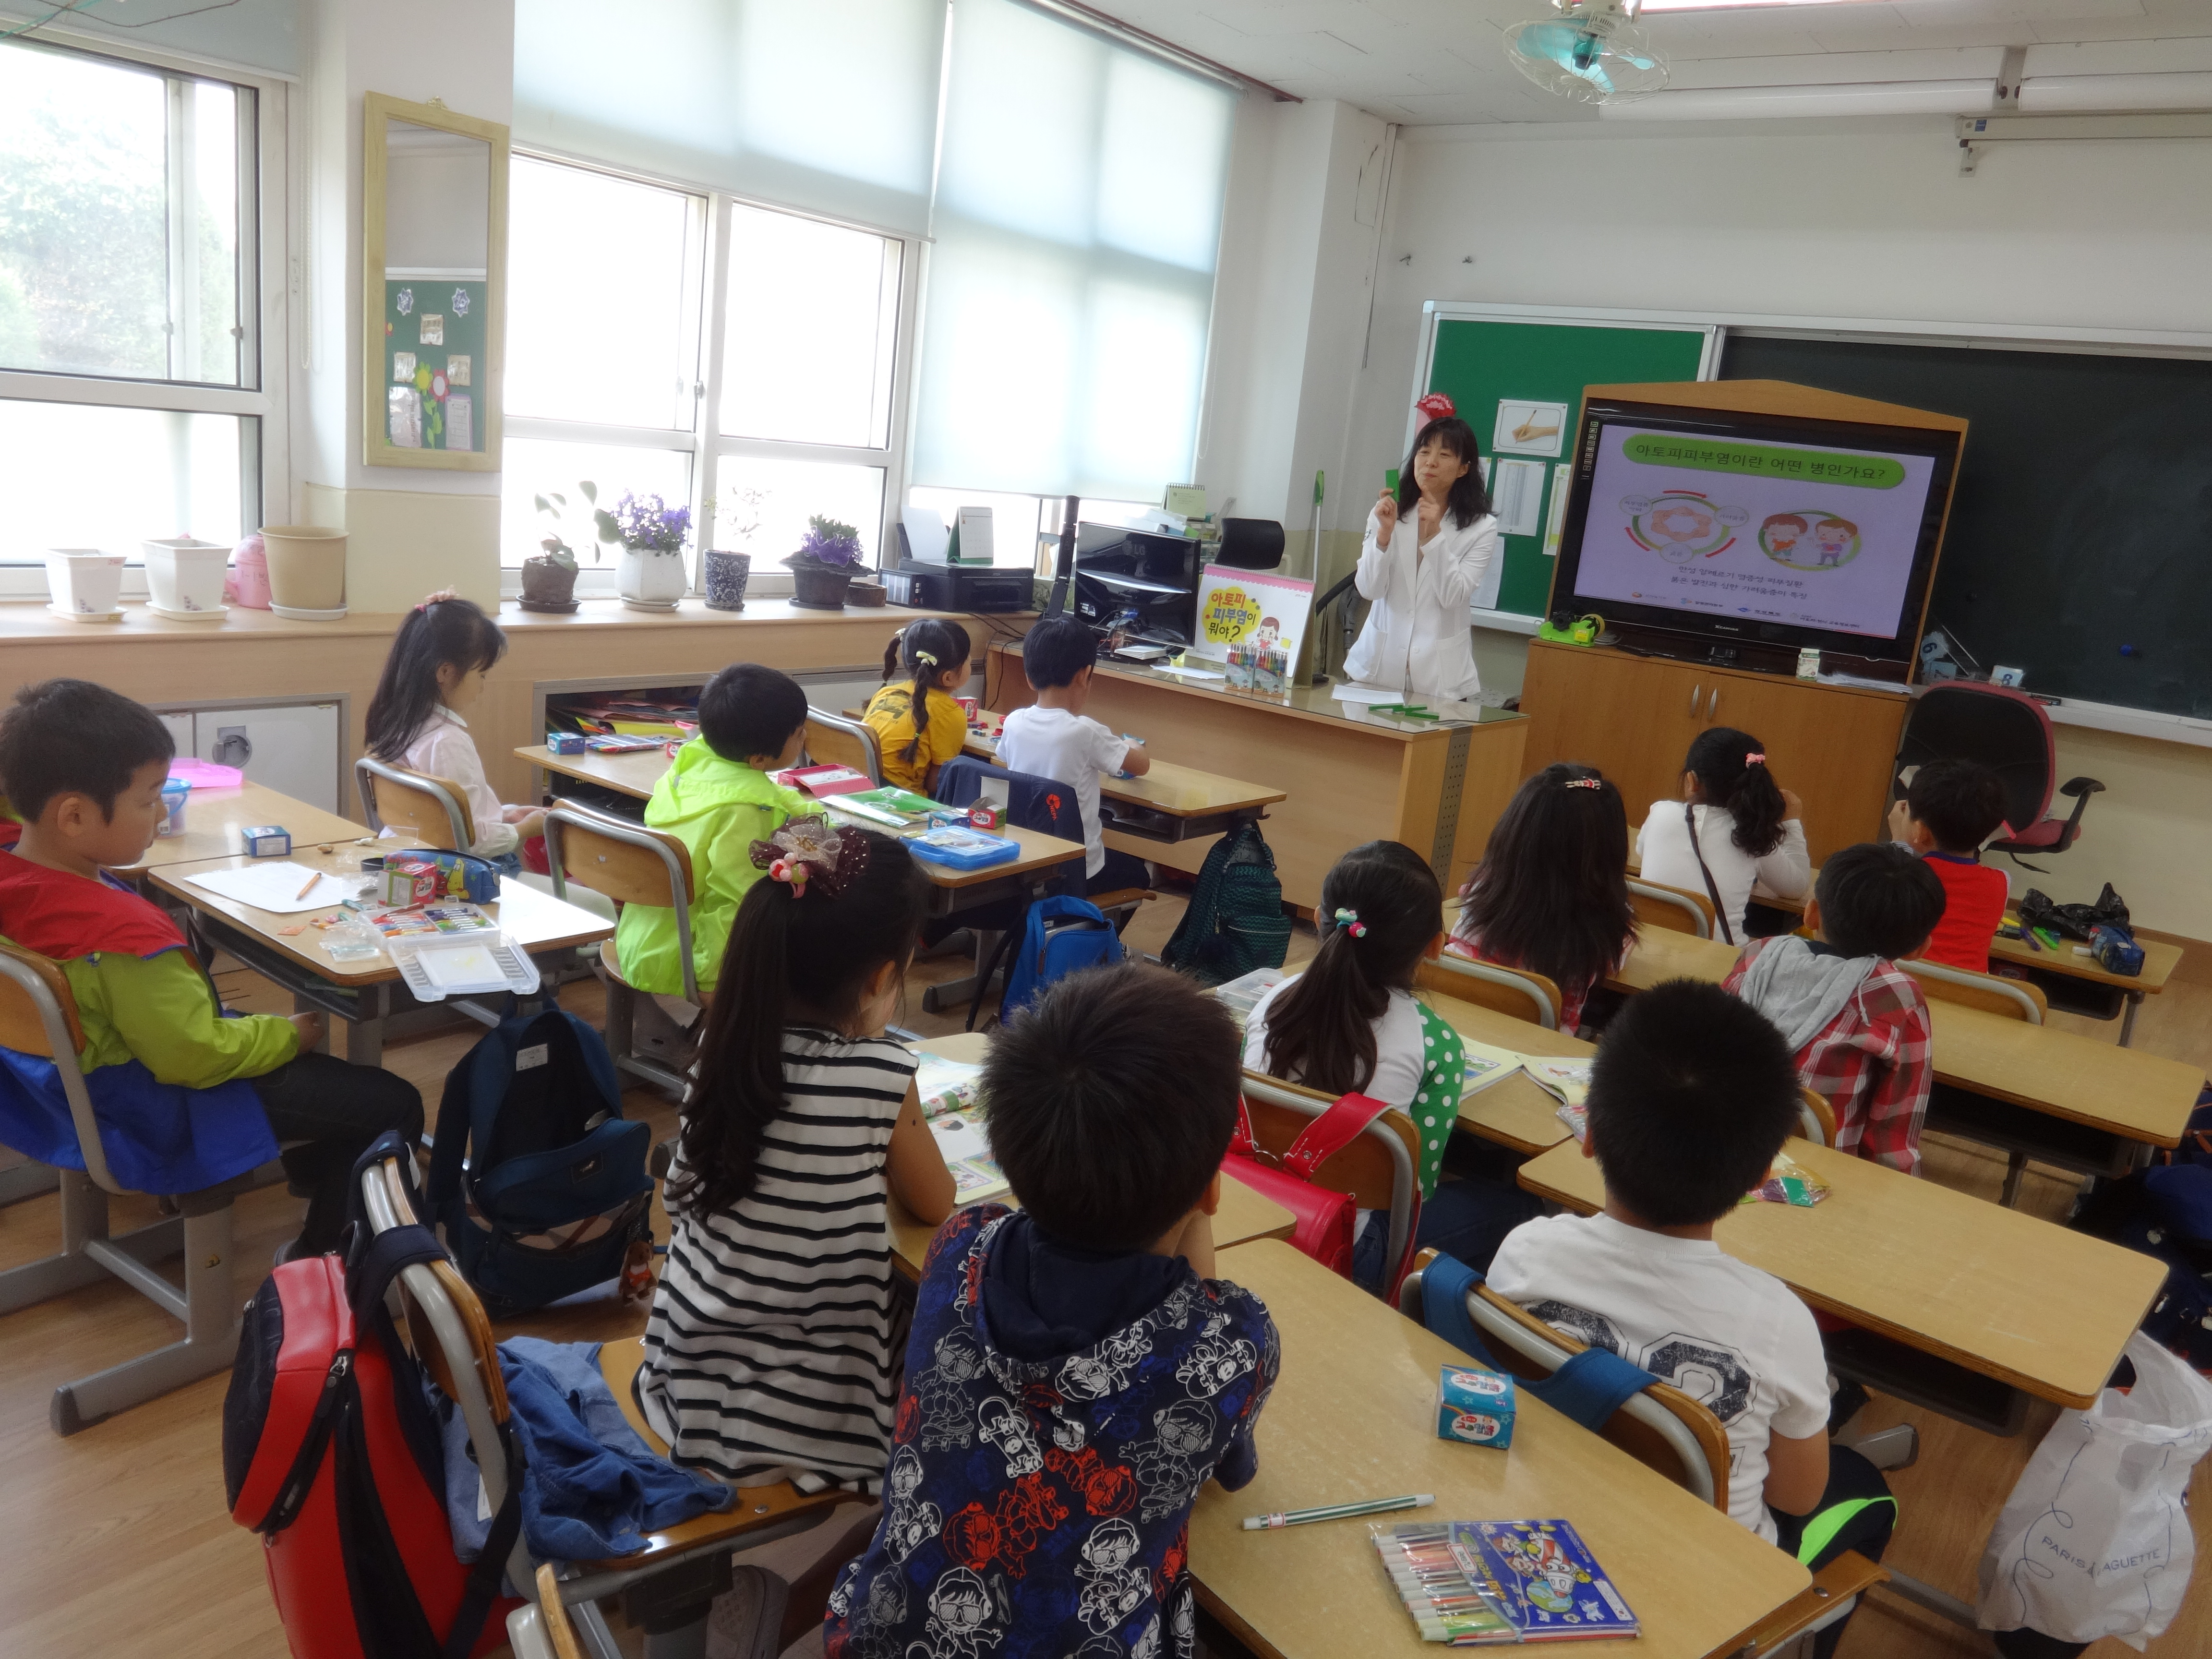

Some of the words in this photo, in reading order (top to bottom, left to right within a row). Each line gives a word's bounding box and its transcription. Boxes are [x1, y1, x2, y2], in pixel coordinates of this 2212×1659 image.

[1636, 445, 1763, 469] 아토피피부염이란
[1771, 458, 1802, 473] 어떤
[1810, 462, 1885, 480] 병인가요?
[1134, 543, 1145, 555] LG
[1679, 566, 1696, 574] 만성
[1699, 569, 1734, 578] 알레르기
[1738, 574, 1763, 583] 염증성
[1767, 577, 1803, 588] 피부질환
[1211, 592, 1247, 609] 아토피
[1212, 608, 1256, 625] 피부염이
[1208, 623, 1241, 642] 뭐야?
[2041, 1536, 2086, 1568] PARIS
